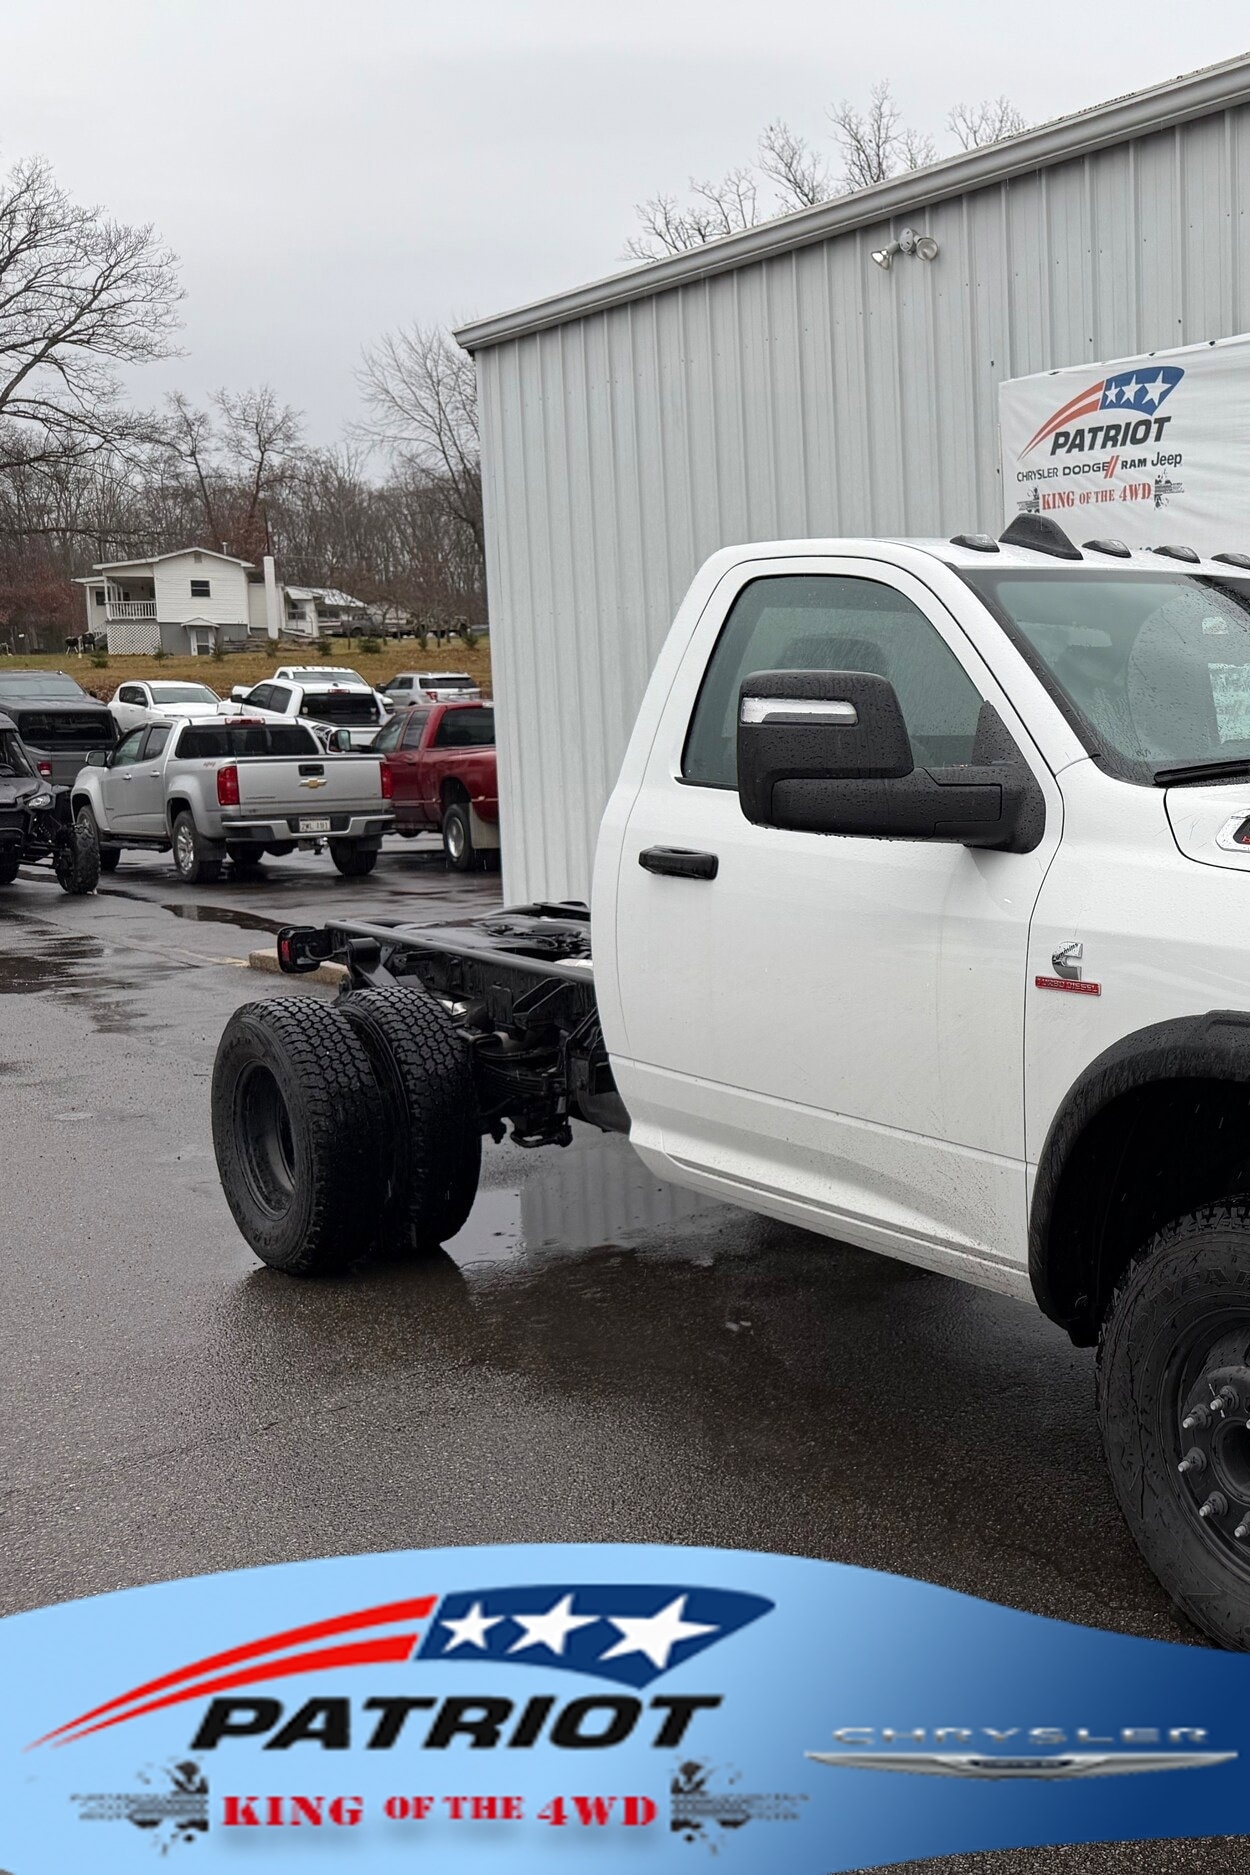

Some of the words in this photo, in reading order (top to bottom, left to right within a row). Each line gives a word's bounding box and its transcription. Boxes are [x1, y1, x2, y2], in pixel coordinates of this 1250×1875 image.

[1050, 416, 1172, 456] PATRIOT
[1016, 467, 1059, 482] CHRYSLER
[1062, 462, 1110, 476] DODGE
[1121, 458, 1147, 470] RAM
[1151, 452, 1182, 468] Jeep
[1041, 491, 1075, 510] KING
[1079, 492, 1093, 505] OF
[1094, 489, 1115, 503] THE
[1119, 482, 1151, 501] 4WD
